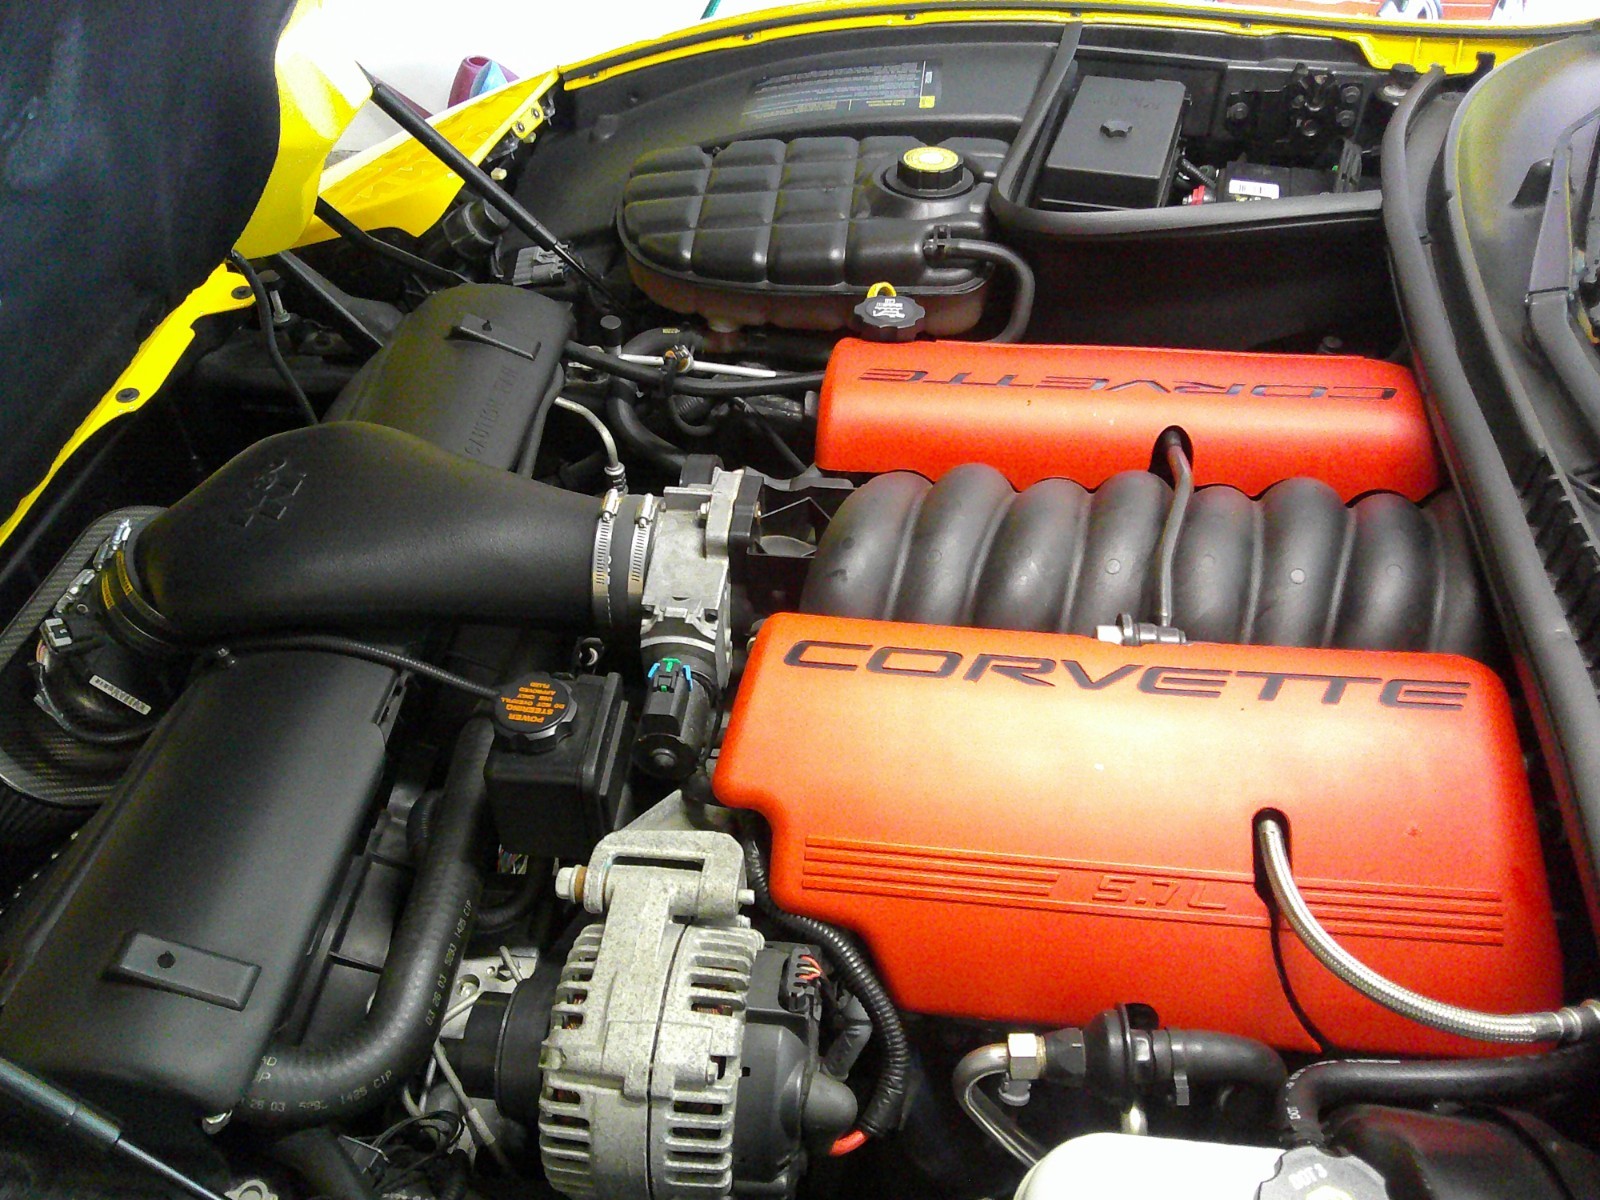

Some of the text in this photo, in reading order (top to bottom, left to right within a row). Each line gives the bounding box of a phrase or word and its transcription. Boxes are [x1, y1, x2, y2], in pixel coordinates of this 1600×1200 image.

[858, 367, 1398, 400] CORVETTE
[784, 639, 1471, 710] CORVETTE
[500, 697, 533, 706] OVERFILL
[505, 704, 554, 715] STEERING
[508, 713, 544, 723] POWER
[1091, 873, 1228, 910] 5.7L
[425, 1009, 436, 1026] 03
[437, 973, 447, 989] 03
[270, 1101, 286, 1112] 03
[1288, 1162, 1328, 1190] DOT 3
